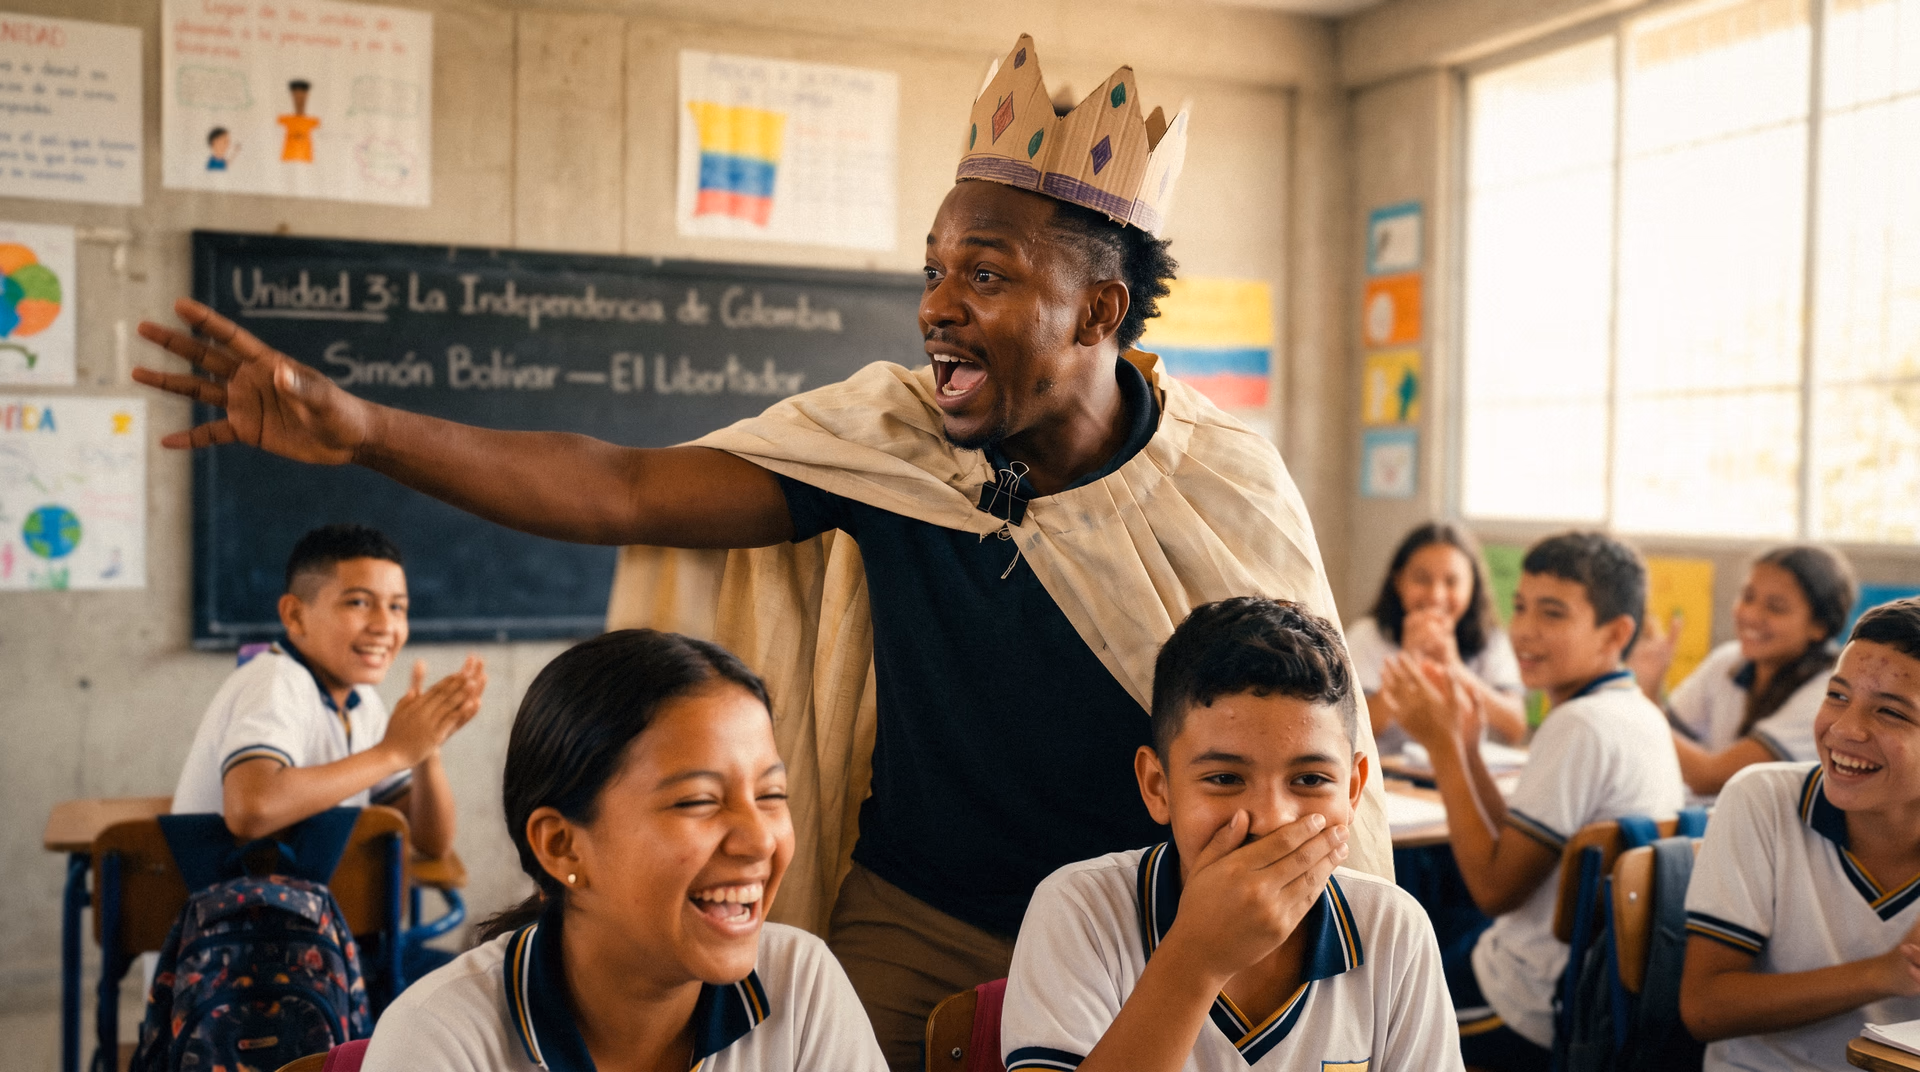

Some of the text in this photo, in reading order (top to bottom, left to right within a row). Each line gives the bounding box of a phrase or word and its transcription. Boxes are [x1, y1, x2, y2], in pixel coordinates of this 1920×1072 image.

[232, 267, 843, 333] Unidad 3: La Independencia de Colombia
[324, 342, 433, 388] Simón
[449, 345, 560, 391] Bolívar
[610, 352, 645, 394] El
[655, 353, 805, 396] Libertador
